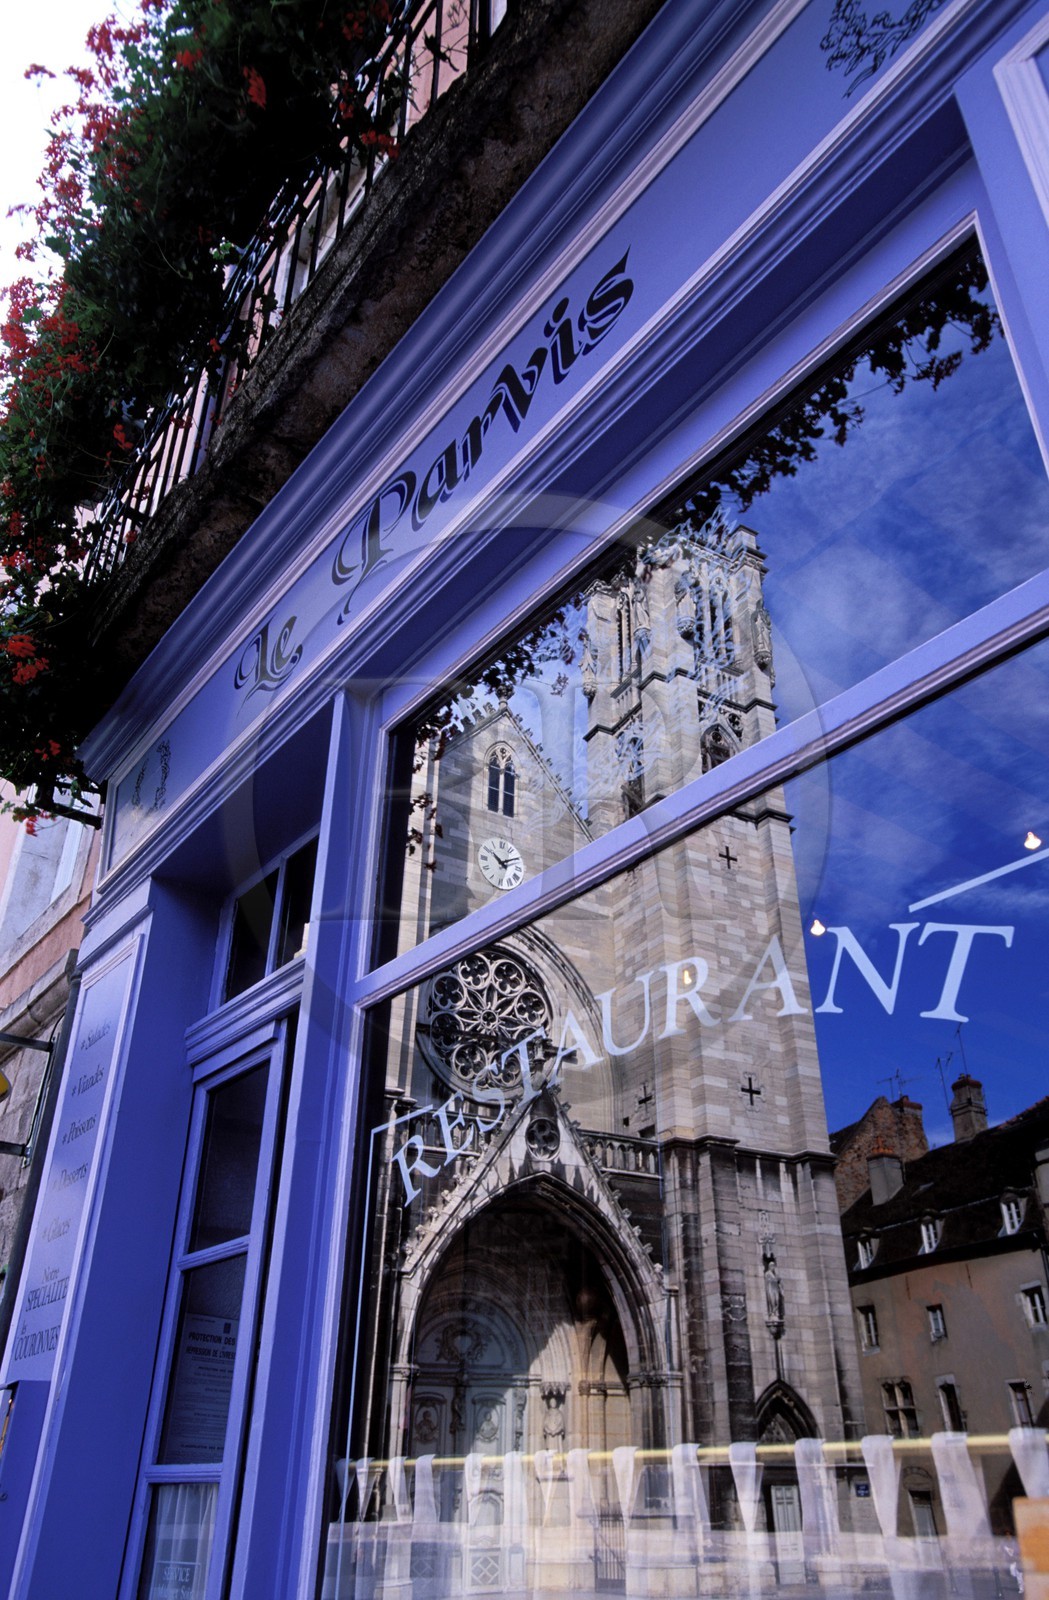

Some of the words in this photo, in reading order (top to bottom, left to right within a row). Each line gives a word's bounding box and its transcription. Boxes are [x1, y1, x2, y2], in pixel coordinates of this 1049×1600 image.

[233, 615, 303, 712] Le
[331, 243, 635, 626] Parvis
[391, 921, 1015, 1208] RESTAURANT
[76, 1064, 105, 1097] Viandes
[41, 1266, 60, 1284] Notre
[188, 1331, 222, 1344] PROTECTION
[224, 1336, 236, 1346] DES
[163, 1566, 191, 1582] SERVICE
